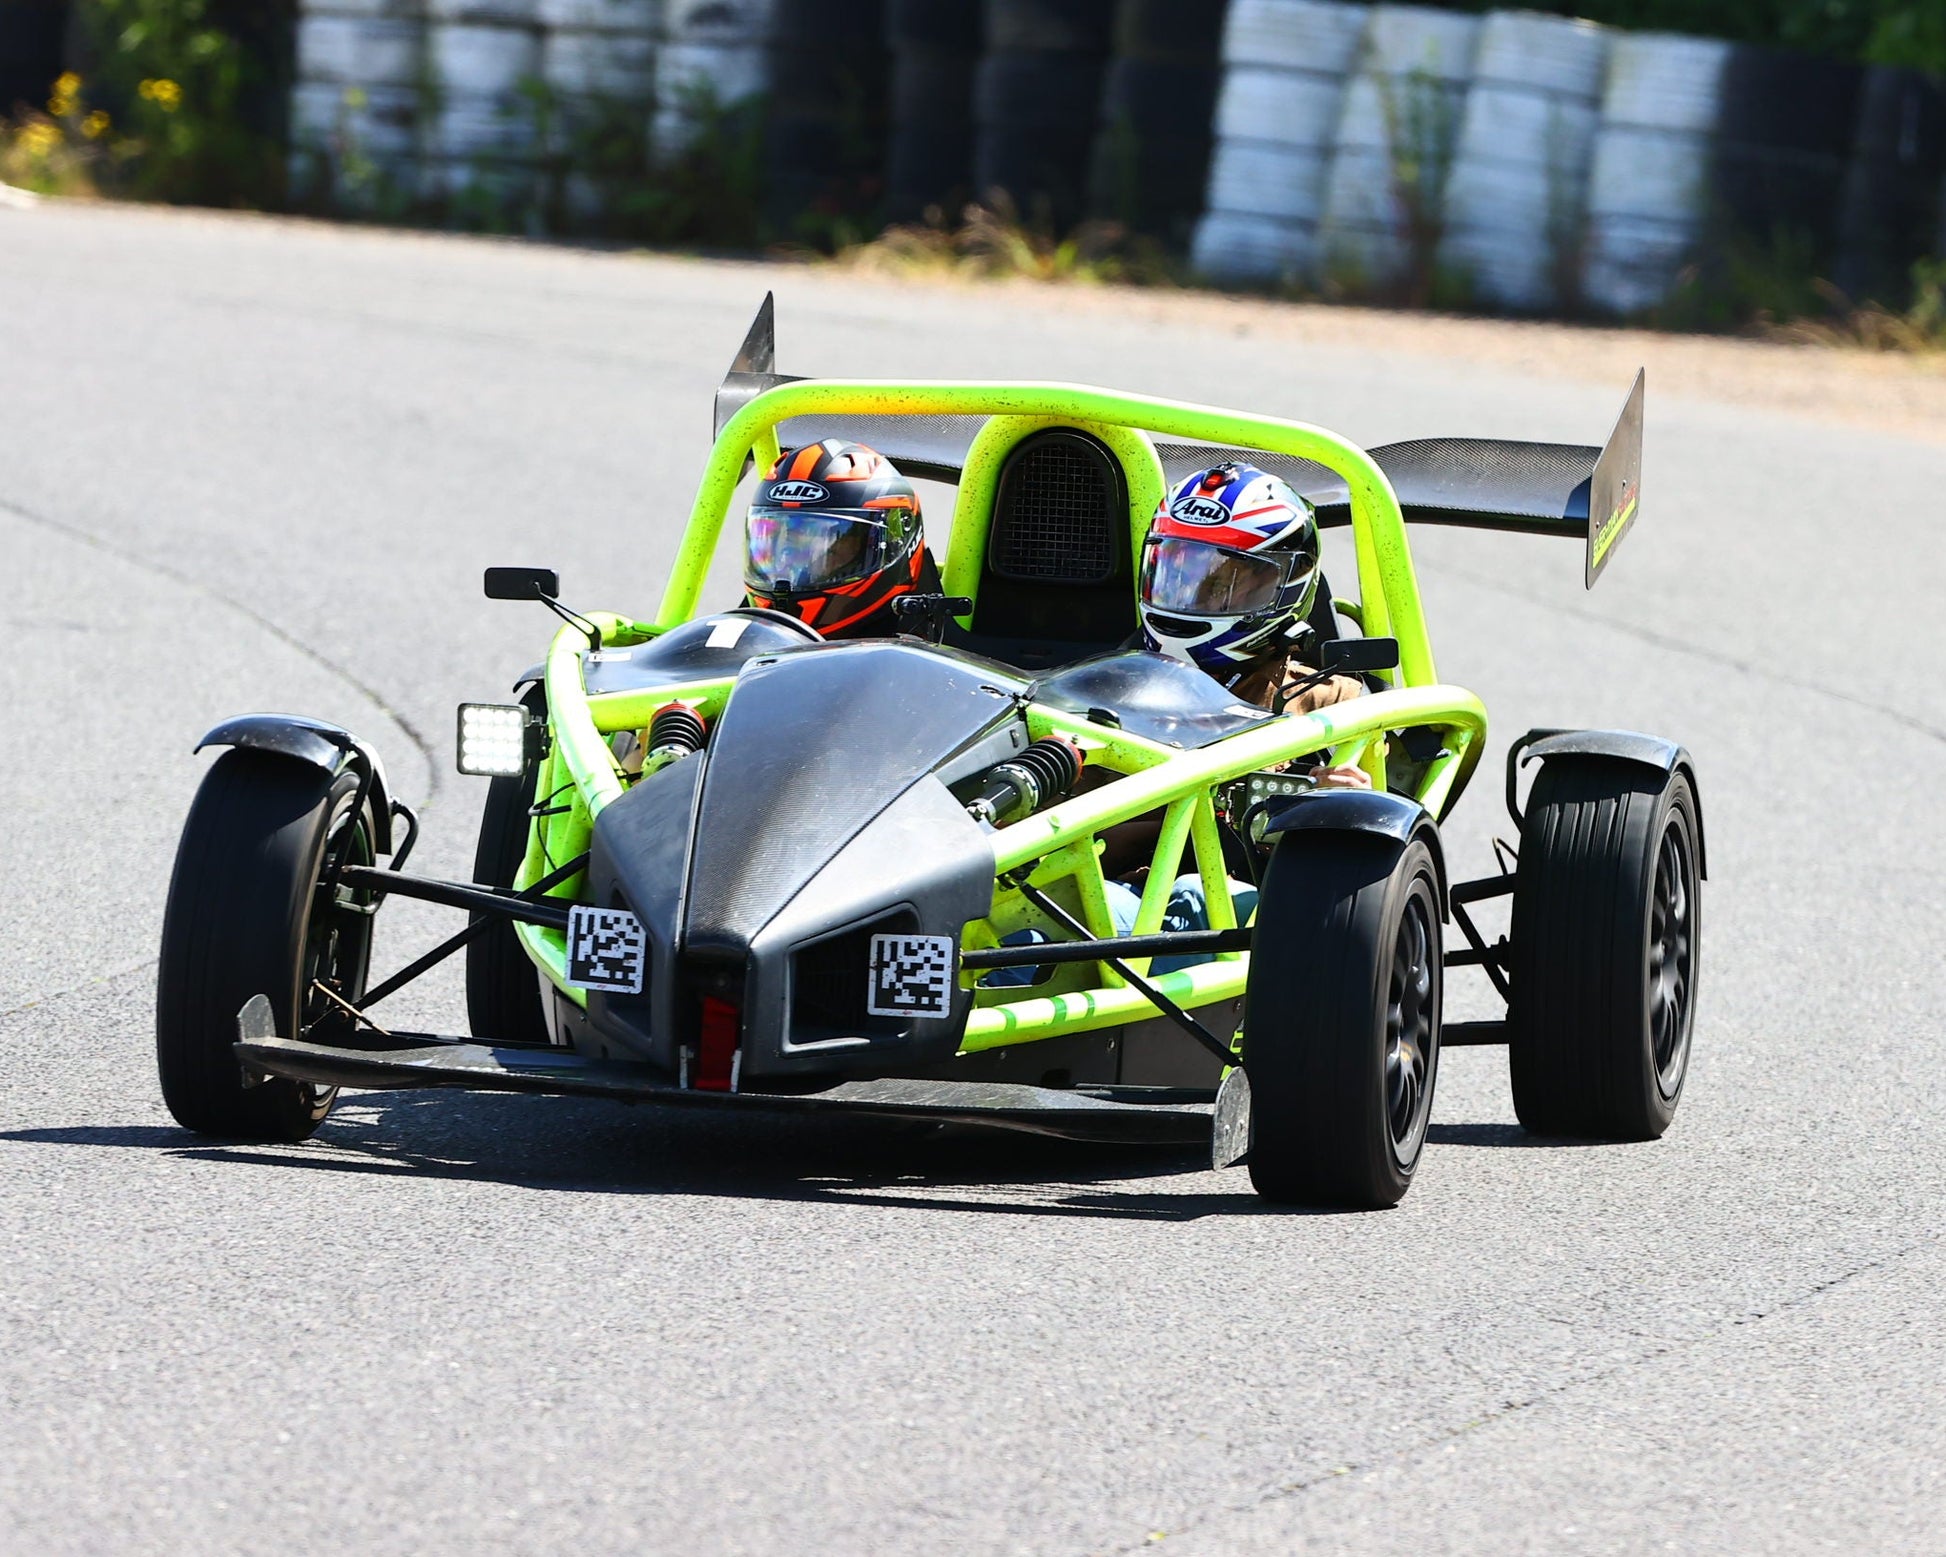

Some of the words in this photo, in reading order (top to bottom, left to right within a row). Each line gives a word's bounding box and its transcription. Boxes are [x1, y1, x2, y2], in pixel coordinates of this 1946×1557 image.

[772, 485, 820, 498] HJC
[1173, 499, 1222, 520] Arai
[705, 618, 752, 649] 1
